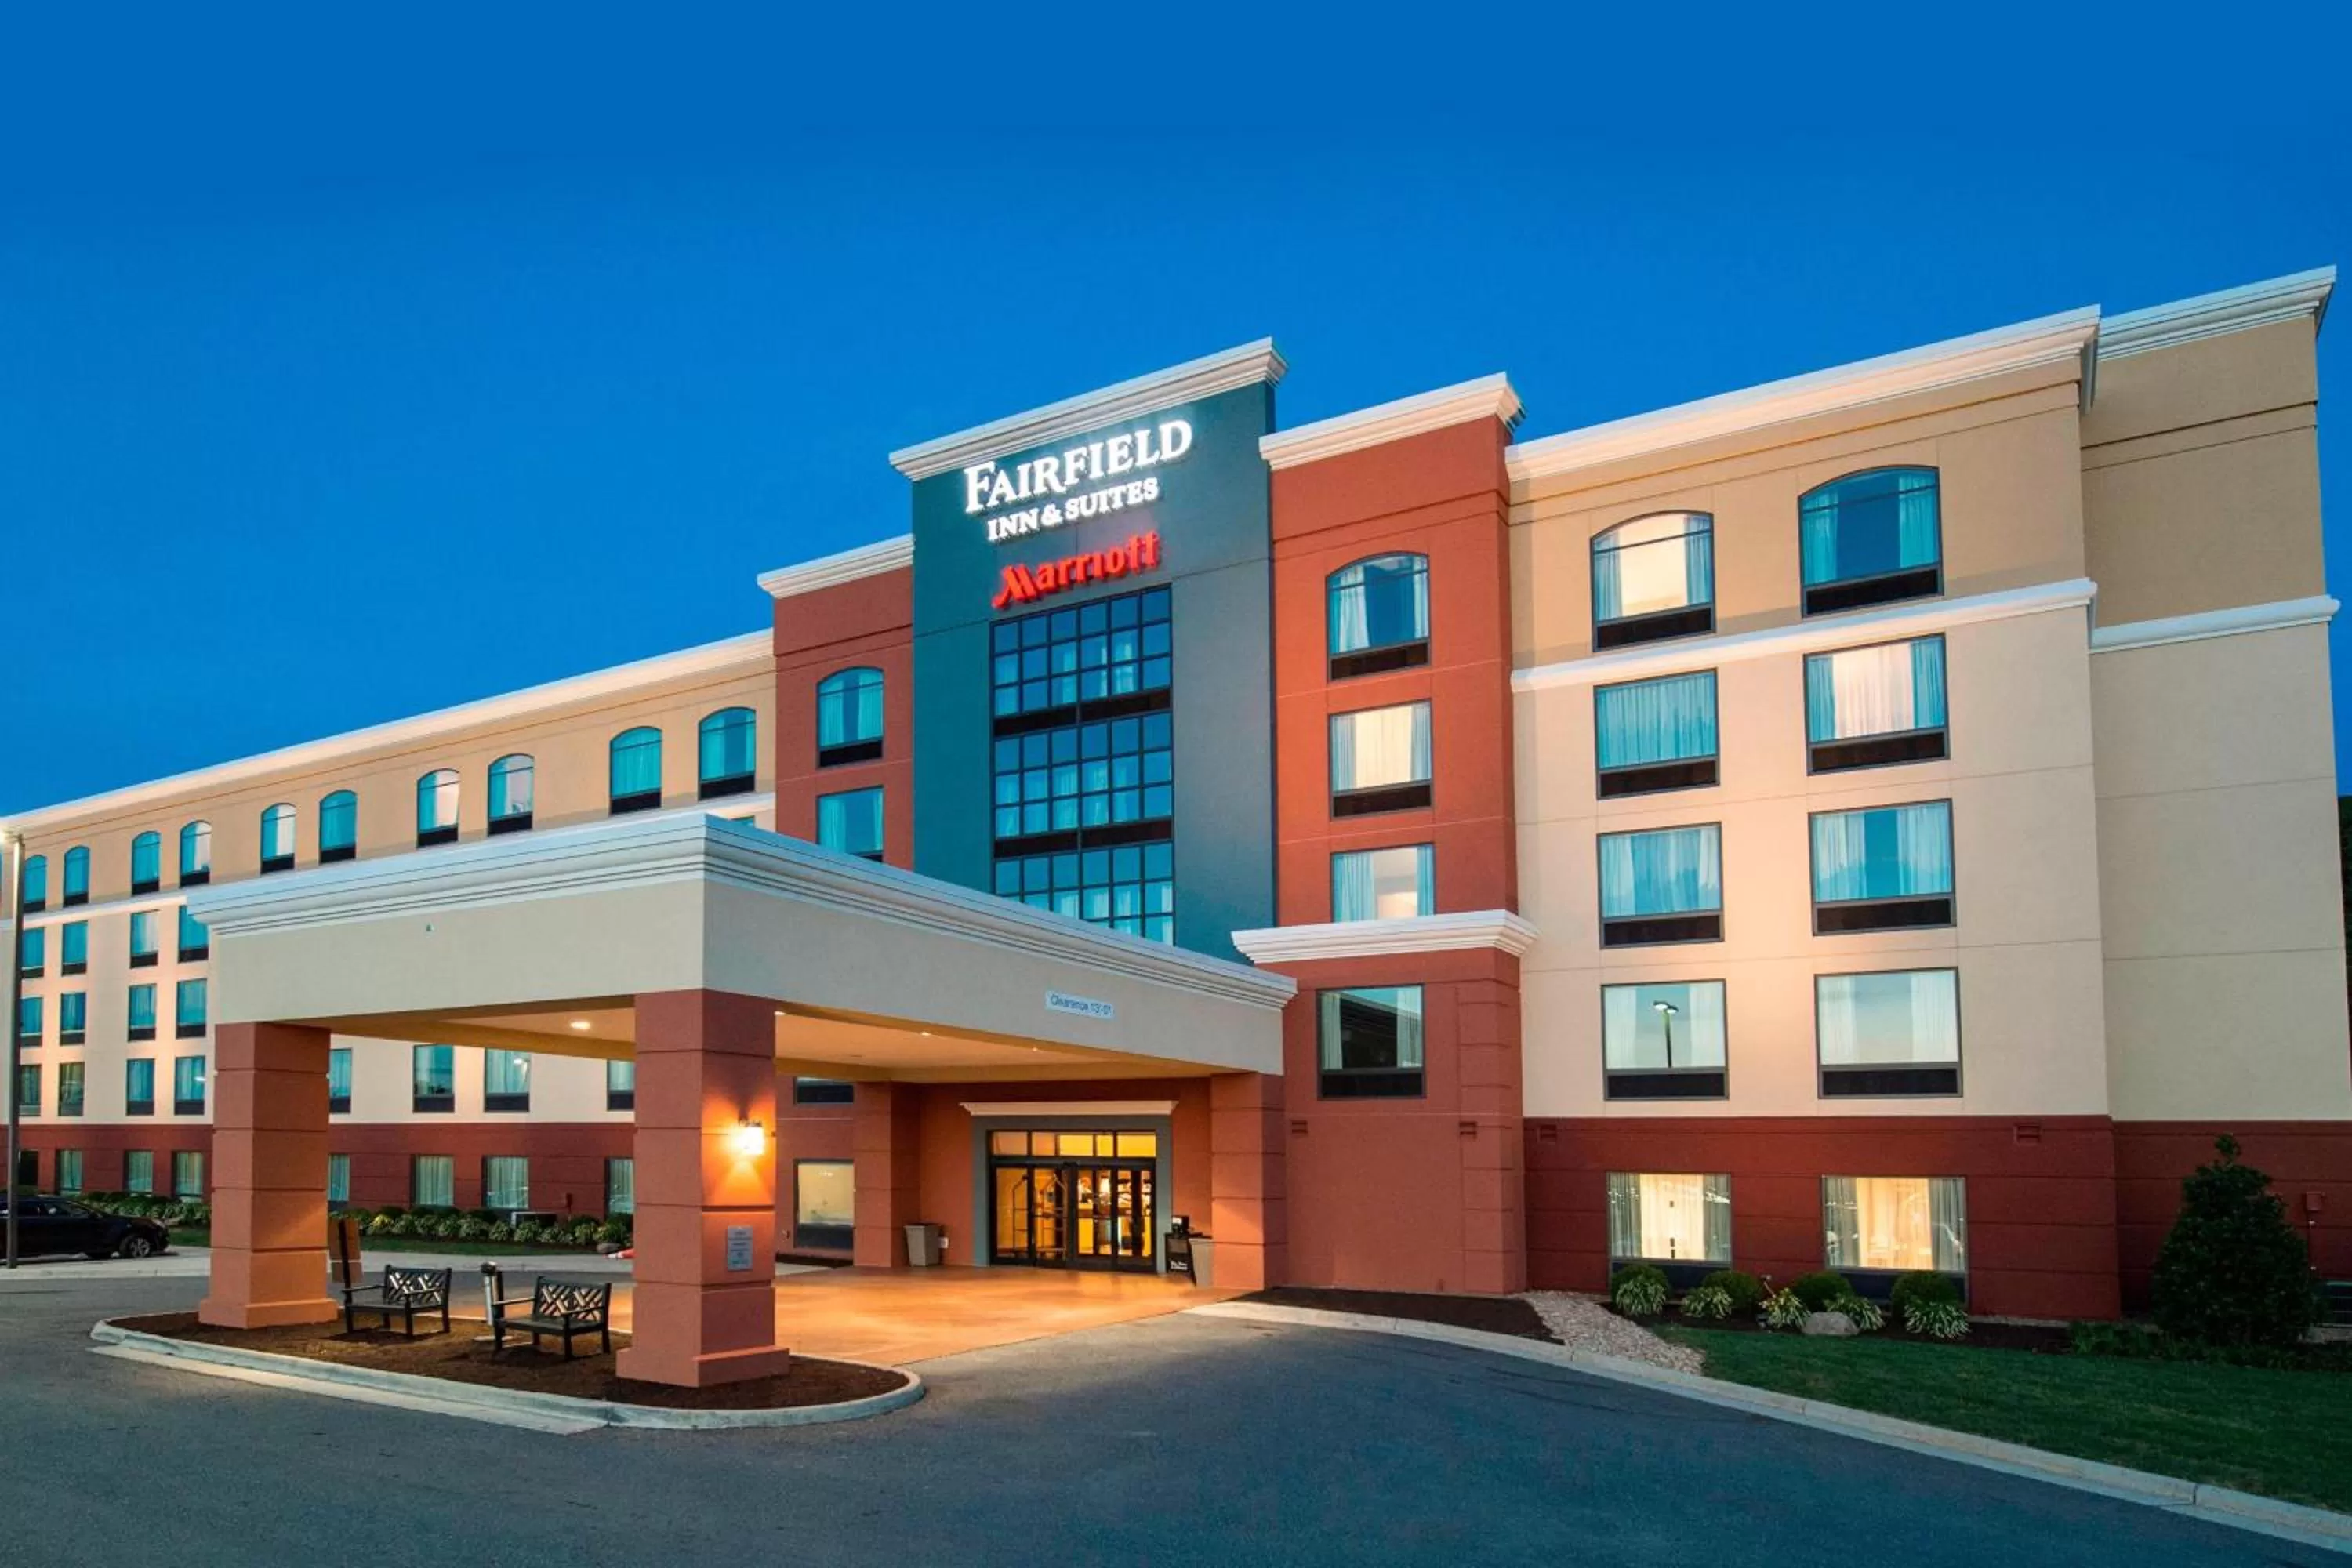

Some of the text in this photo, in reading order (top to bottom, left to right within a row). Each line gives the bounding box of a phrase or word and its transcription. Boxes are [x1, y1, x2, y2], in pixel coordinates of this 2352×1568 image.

[964, 420, 1192, 514] FAIRFIELD
[1065, 477, 1159, 520] SUITES
[993, 529, 1159, 608] Marriott
